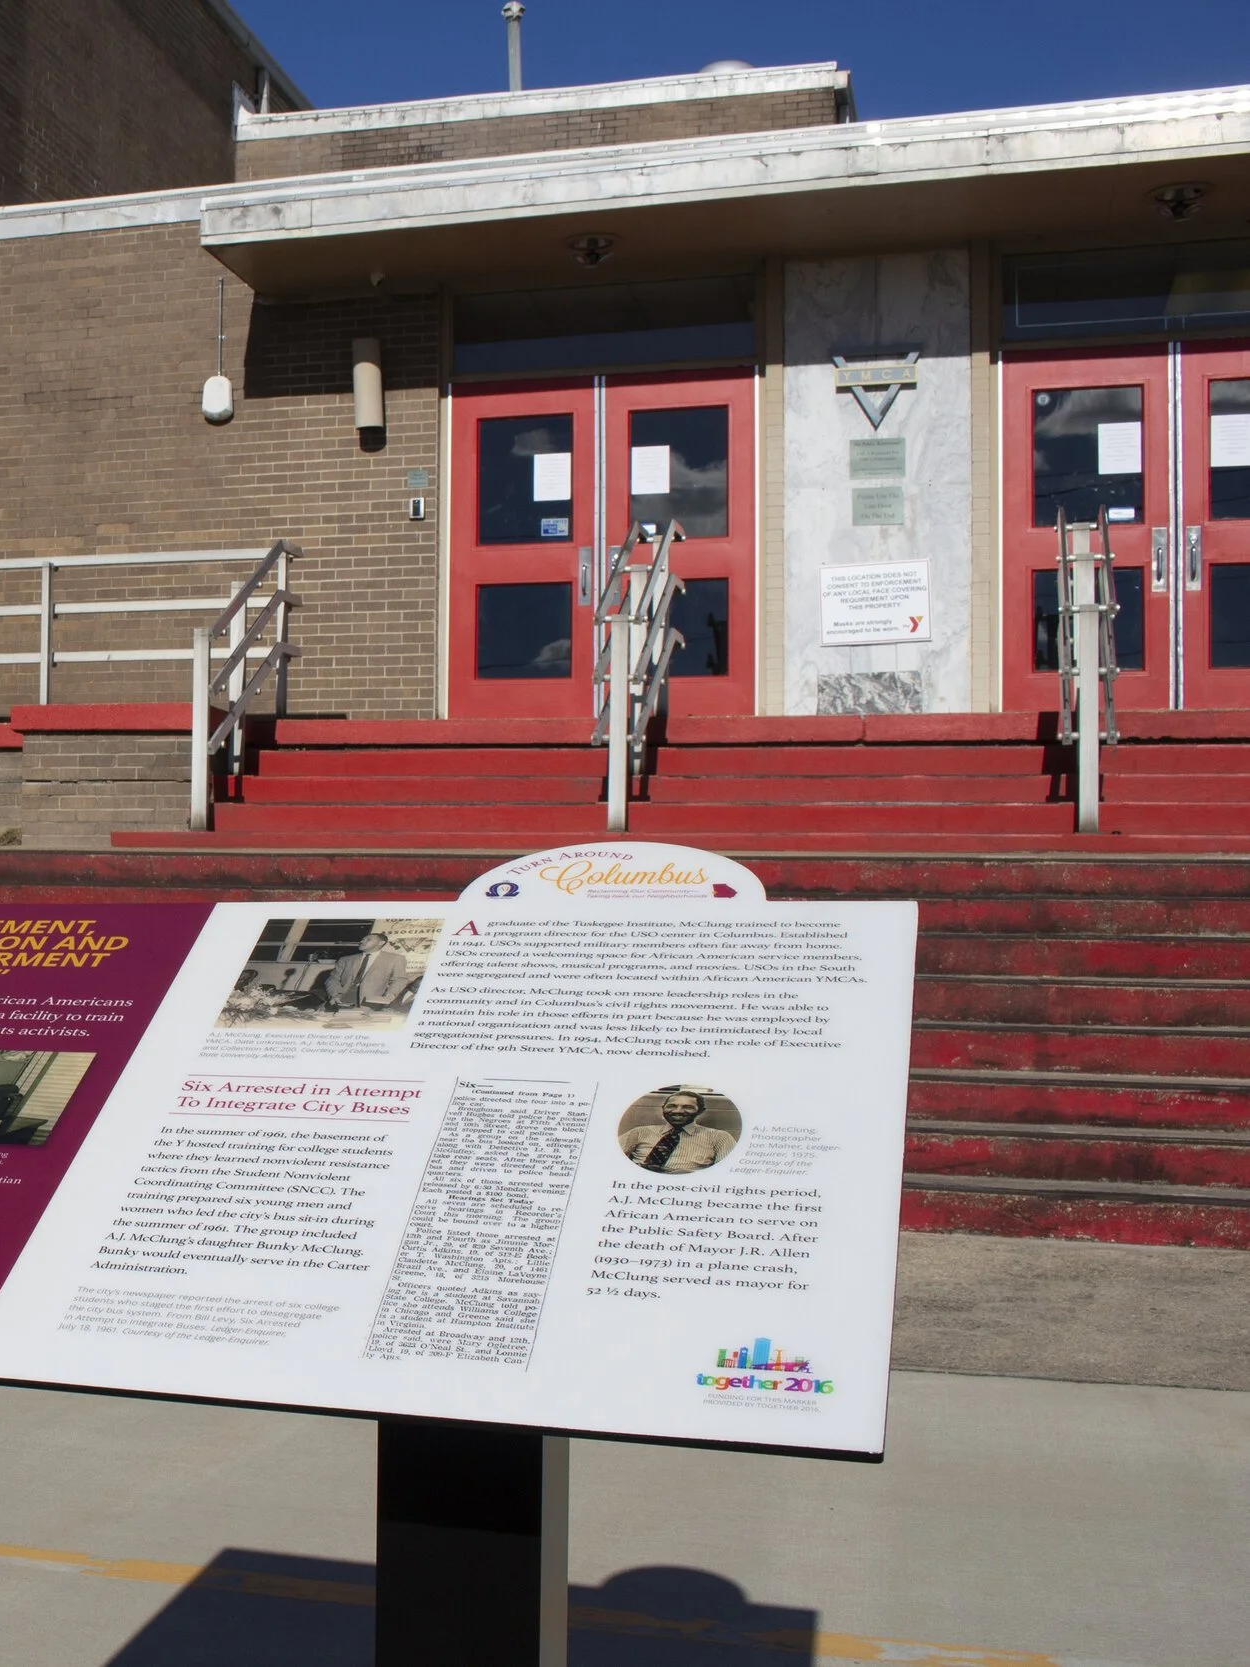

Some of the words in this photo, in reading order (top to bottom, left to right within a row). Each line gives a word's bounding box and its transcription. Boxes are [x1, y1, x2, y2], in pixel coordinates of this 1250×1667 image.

[843, 368, 911, 381] YMCA
[539, 860, 709, 895] Columbus
[452, 920, 480, 937] A
[573, 920, 624, 928] Tuskegee
[679, 921, 732, 929] McClung
[52, 936, 129, 950] AND
[40, 996, 133, 1006] Americans
[8, 1010, 63, 1023] facility
[65, 1013, 82, 1021] to
[85, 1012, 124, 1021] train
[18, 1026, 90, 1036] activists.
[497, 1044, 516, 1052] 9th
[559, 1046, 603, 1055] YMCA,
[635, 1048, 710, 1057] demolished.
[181, 1080, 212, 1091] Six
[218, 1082, 306, 1094] Arrested
[311, 1084, 330, 1095] in
[337, 1085, 422, 1101] Attempt
[177, 1096, 200, 1107] To
[206, 1097, 296, 1112] Integrate
[302, 1100, 344, 1115] City
[350, 1102, 410, 1114] Buses
[148, 1151, 183, 1160] where
[186, 1153, 211, 1163] they
[214, 1154, 260, 1163] learned
[262, 1158, 326, 1166] nonviolent
[329, 1160, 390, 1169] resistance
[134, 1178, 213, 1190] Coordinating
[216, 1182, 284, 1192] Committee
[287, 1185, 336, 1195] (SNCC).
[341, 1188, 365, 1196] The
[612, 1180, 626, 1188] In
[631, 1181, 652, 1190] the
[656, 1184, 720, 1193] post-civil
[725, 1186, 765, 1196] rights
[770, 1188, 821, 1198] period,
[608, 1195, 632, 1204] A.J.
[637, 1196, 702, 1209] McClung
[707, 1199, 762, 1209] became
[767, 1202, 789, 1211] the
[795, 1203, 822, 1212] first
[105, 1232, 125, 1241] A.J.
[129, 1233, 194, 1246] McClung's
[197, 1237, 254, 1249] daughter
[256, 1241, 298, 1253] Bunky
[301, 1244, 363, 1257] McClung.
[677, 1259, 690, 1268] in
[708, 1261, 749, 1271] plane
[753, 1264, 797, 1274] crash,
[586, 1287, 601, 1296] 52
[623, 1287, 660, 1300] days.
[696, 1374, 783, 1391] together
[785, 1378, 835, 1394] 2016
